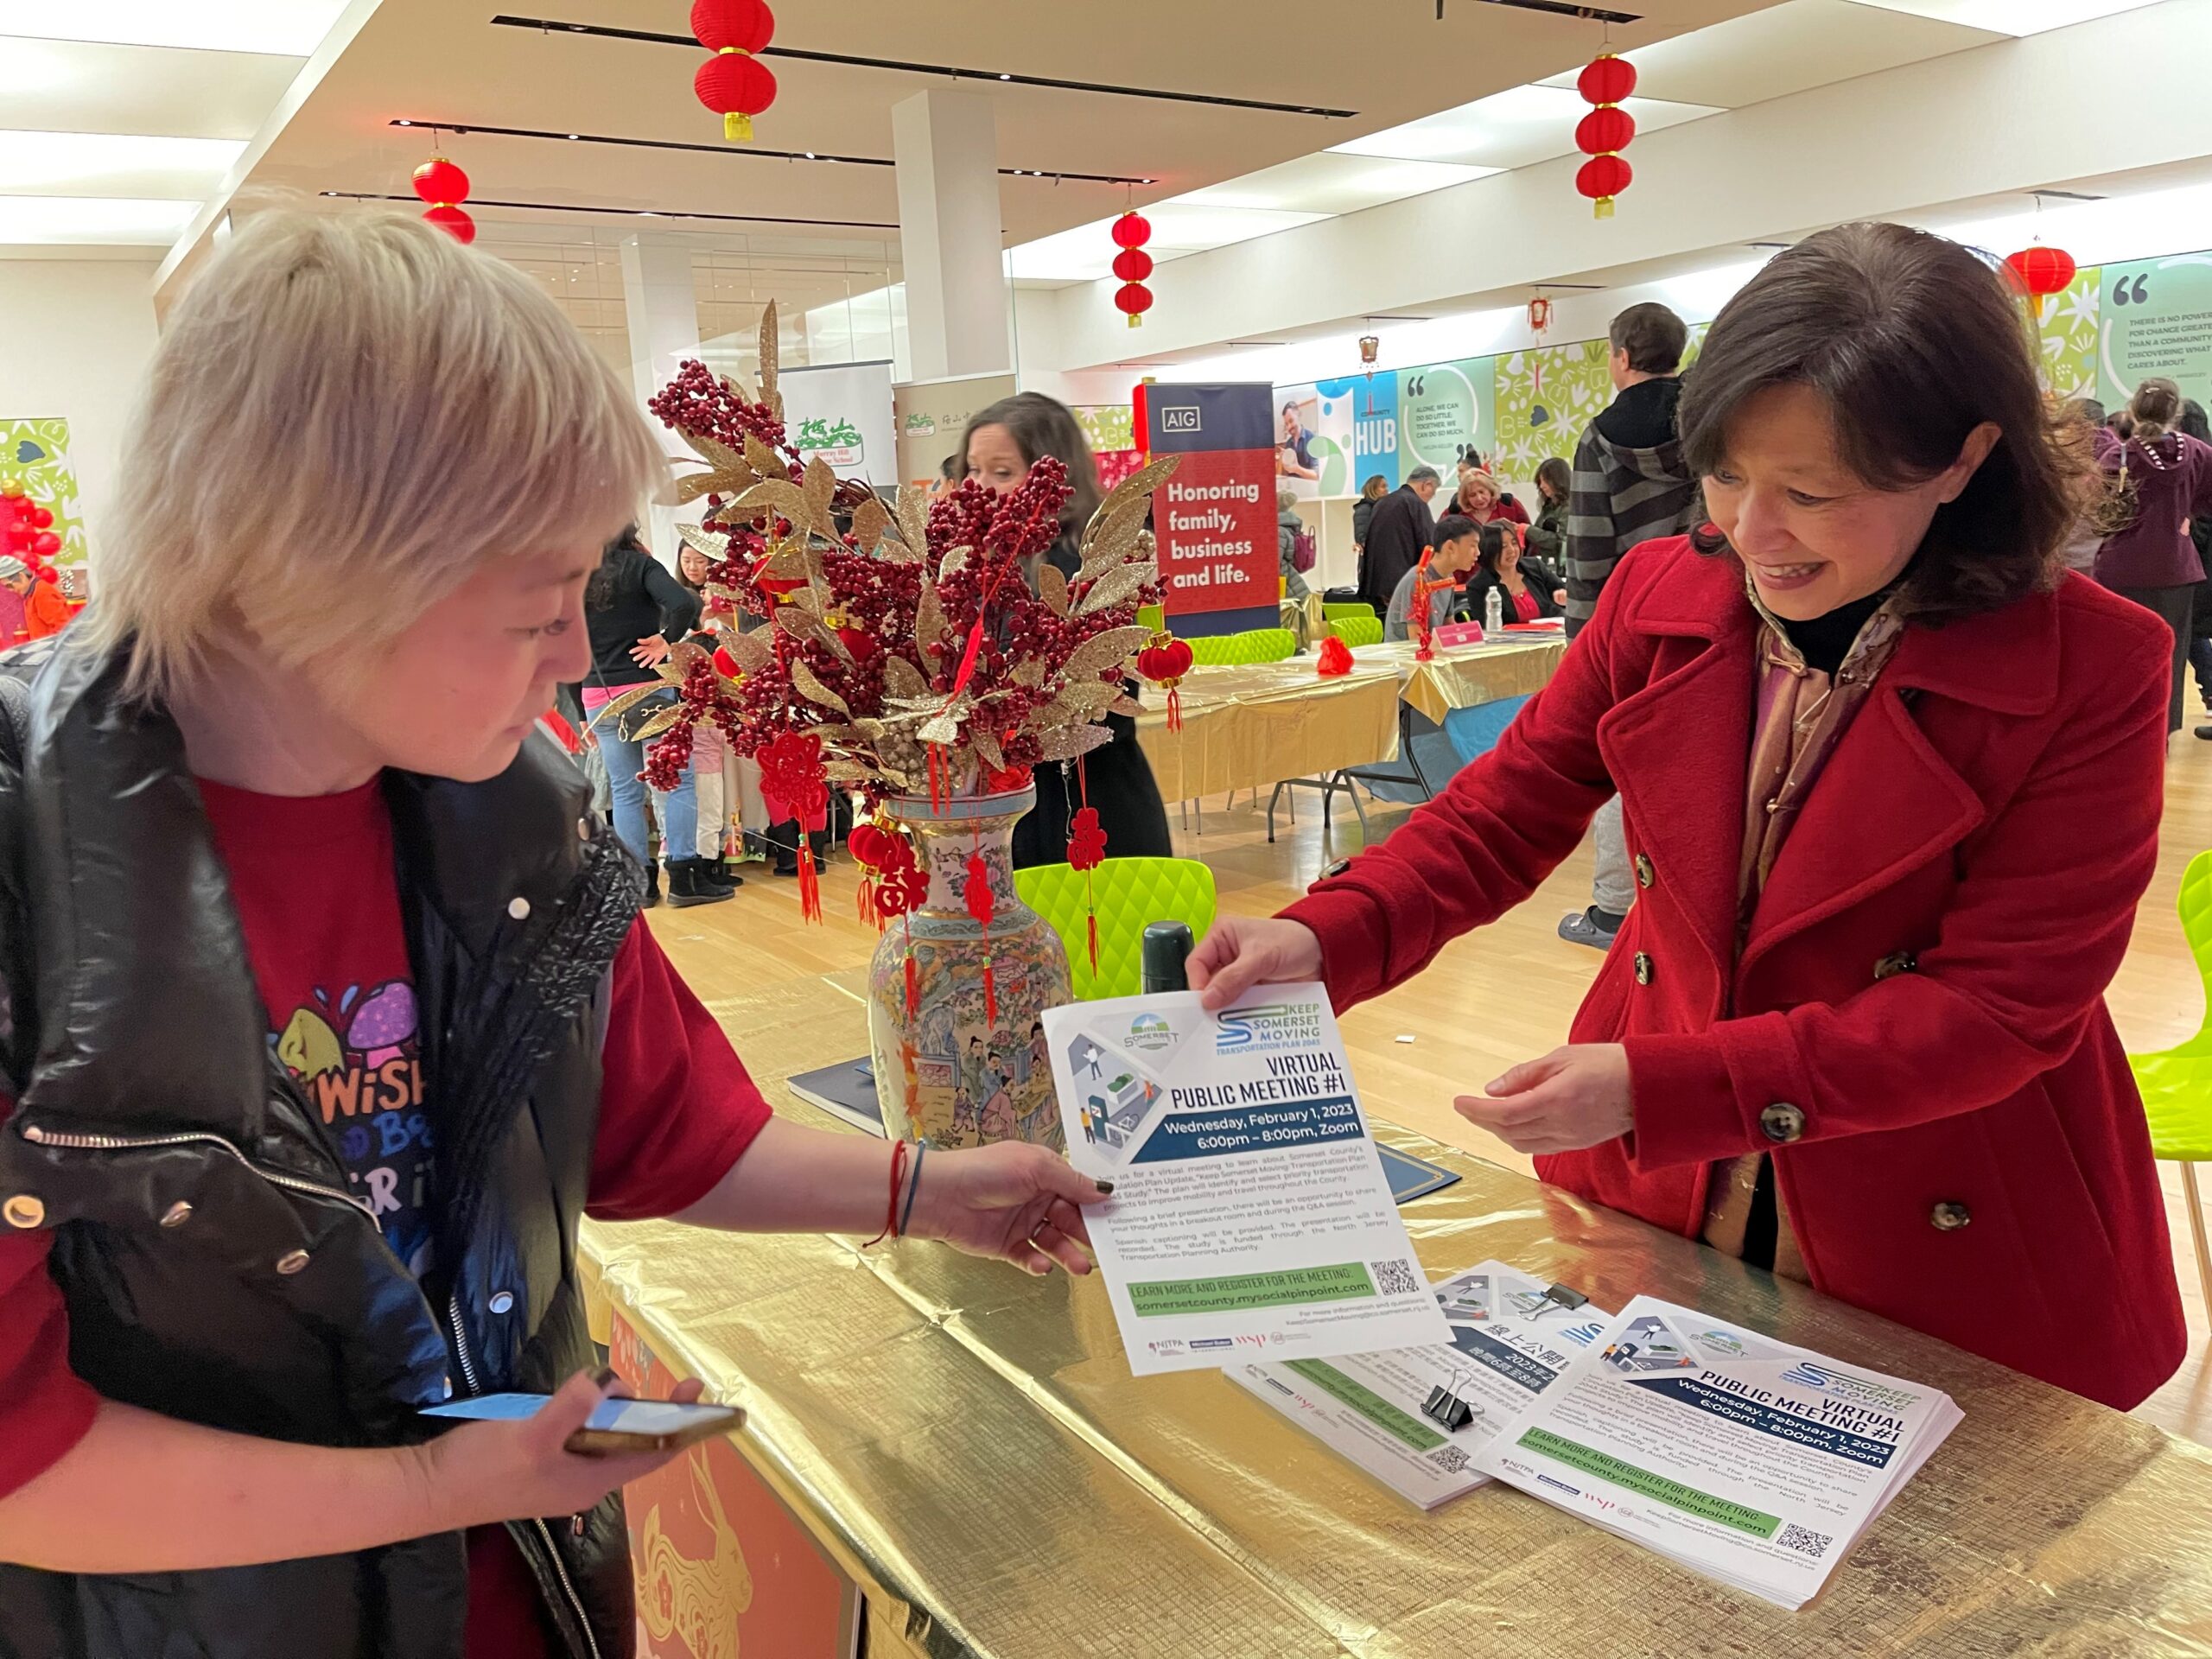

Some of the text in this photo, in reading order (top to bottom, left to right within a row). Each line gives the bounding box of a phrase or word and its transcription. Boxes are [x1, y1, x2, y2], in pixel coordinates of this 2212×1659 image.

[2130, 317, 2156, 326] THERE
[2146, 327, 2179, 335] CHANGE
[2181, 323, 2212, 332] GREATE
[2161, 335, 2211, 345] COMMUNITY
[2128, 348, 2183, 359] DISCOVERING
[1167, 411, 1196, 427] AIG
[1356, 418, 1396, 455] HUB
[1168, 480, 1259, 503] Honoring
[1169, 509, 1236, 532] family,
[1172, 538, 1252, 560] business
[1173, 564, 1249, 588] and life.
[1289, 1004, 1319, 1014] KEEP
[1254, 1015, 1319, 1029] SOMERSET
[1260, 1027, 1319, 1041] MOVING
[1217, 1042, 1281, 1056] TRANSPORTATION
[1282, 1040, 1300, 1049] PLAN
[1267, 1052, 1340, 1076] VIRTUAL
[1172, 1084, 1236, 1109] PUBLIC
[1239, 1076, 1319, 1103] MEETING
[1166, 1103, 1353, 1135] Wednesday, February 1, 2023
[1198, 1135, 1249, 1149] 6:00pm
[1262, 1127, 1318, 1142] 8:00pm,
[1321, 1122, 1358, 1135] Zoom
[1183, 1192, 1216, 1200] mobility
[1234, 1185, 1256, 1194] travel
[1258, 1180, 1302, 1191] throughout
[1297, 1192, 1343, 1202] opportunity
[1185, 1216, 1222, 1224] breakout
[1131, 1286, 1163, 1297] LEARN
[1165, 1284, 1193, 1294] MORE
[1196, 1282, 1217, 1293] AND
[1217, 1278, 1265, 1291] REGISTER
[1266, 1275, 1286, 1286] FOR
[1286, 1273, 1306, 1284] THE
[1137, 1284, 1368, 1310] somersetcounty.mysocialpinpoint.com
[1156, 1339, 1184, 1348] NJTPA
[1236, 1334, 1266, 1348] wsp
[1506, 1353, 1554, 1382] 2023年2
[1700, 1371, 1771, 1402] PUBLIC
[1776, 1397, 1866, 1433] MEETING
[1832, 1386, 1905, 1412] MOVING
[1833, 1377, 1914, 1408] SOMERSET
[1881, 1388, 1922, 1400] KEEP
[1680, 1380, 1889, 1454] Wednesday, February 1, 2023
[1823, 1399, 1903, 1432] VIRTUAL
[1700, 1400, 1755, 1423] 6:00pm
[1770, 1425, 1831, 1449] 8:00pm,
[1836, 1445, 1883, 1464] Zoom
[1509, 1460, 1534, 1474] NJTPA
[1529, 1429, 1560, 1445] LEARN
[1560, 1441, 1591, 1457] MORE
[1591, 1454, 1613, 1465] AND
[1613, 1463, 1663, 1486] REGISTER
[1664, 1483, 1686, 1495] FOR
[1688, 1491, 1708, 1503] THE
[1522, 1439, 1765, 1532] somersetcounty.mysocialpinpoint.com
[1586, 1493, 1615, 1510] wsp
[1682, 1518, 1705, 1528] more
[1706, 1525, 1754, 1544] information
